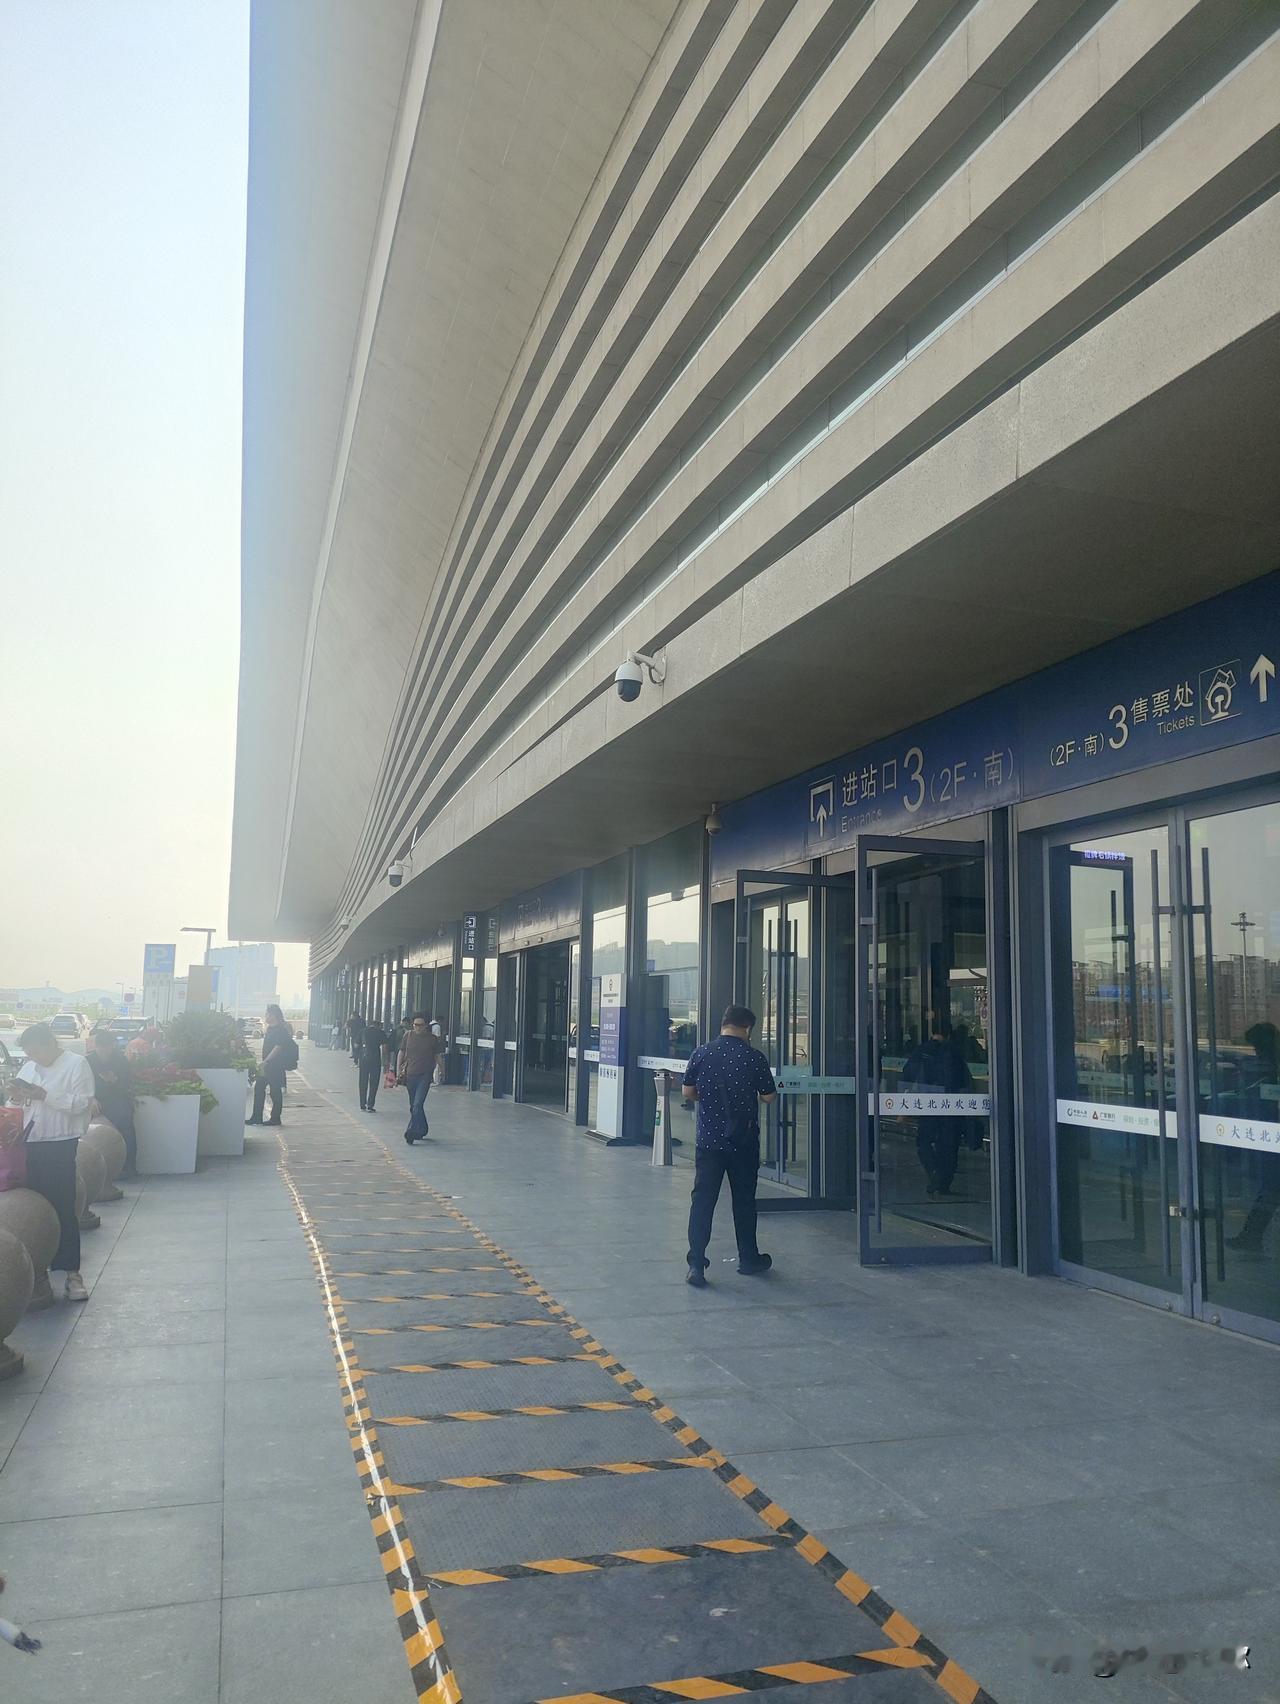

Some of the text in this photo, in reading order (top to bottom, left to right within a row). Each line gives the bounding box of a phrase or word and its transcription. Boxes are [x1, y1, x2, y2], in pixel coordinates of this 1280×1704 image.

[1131, 680, 1194, 726] 售票处
[1156, 714, 1195, 736] Tickets
[1108, 704, 1129, 750] 3
[841, 758, 897, 808] 进站口
[903, 746, 925, 813] 3
